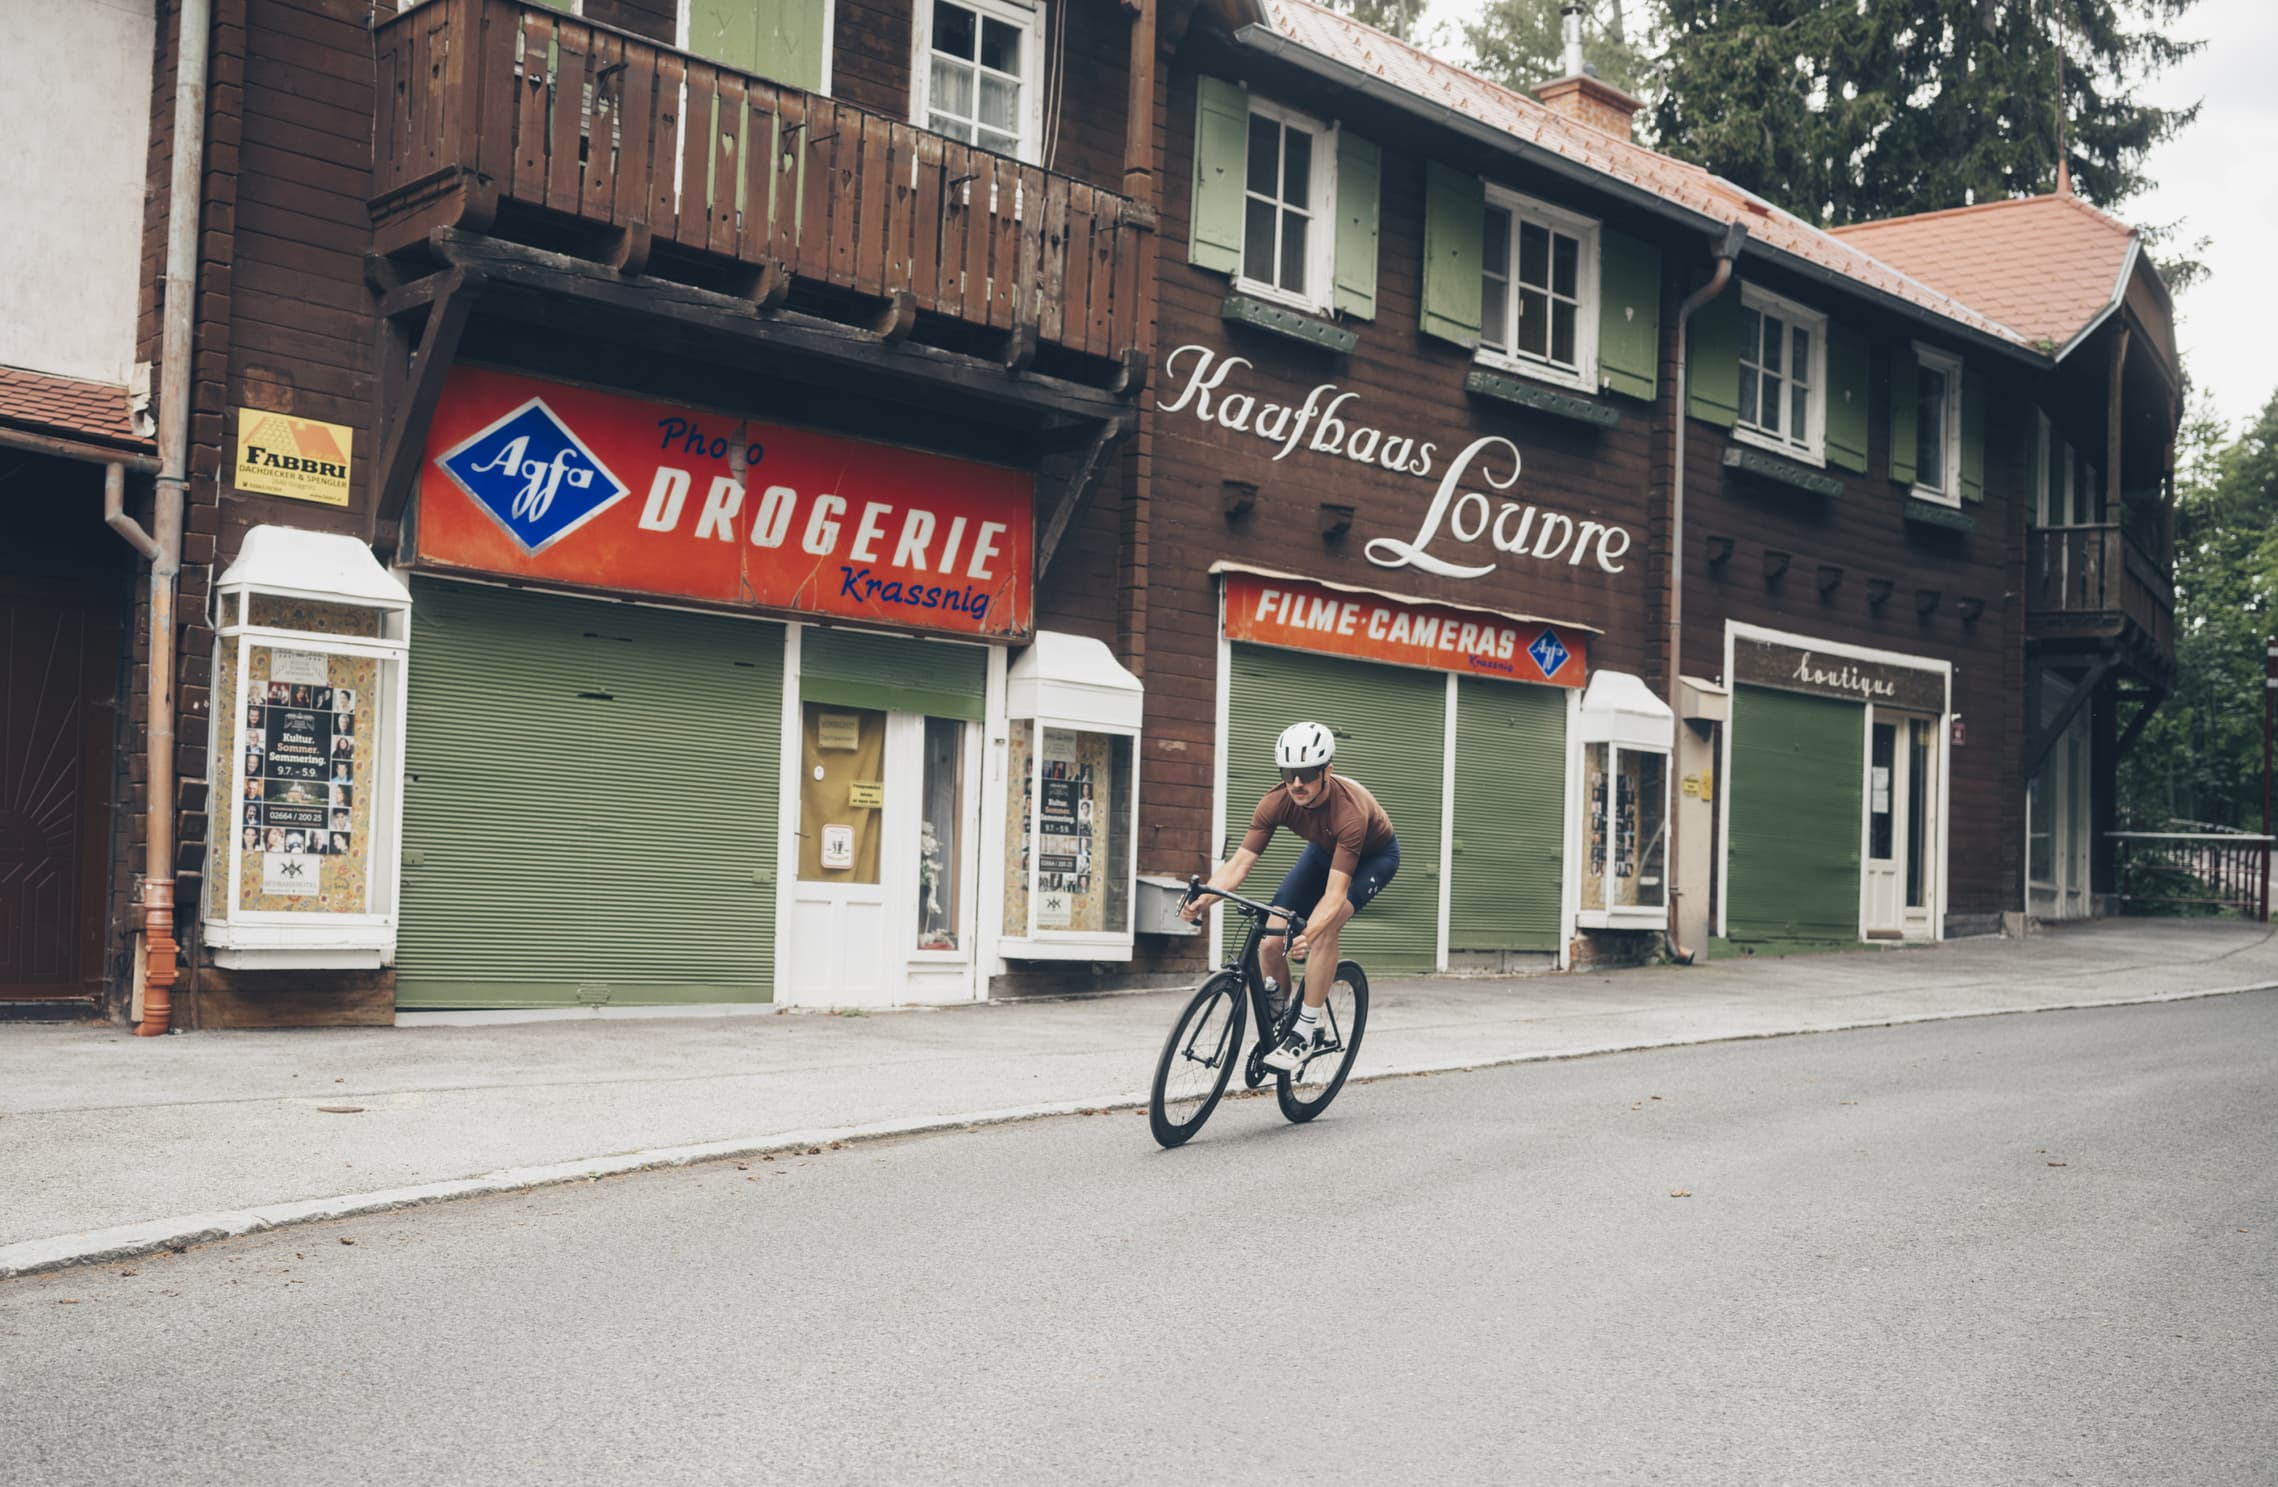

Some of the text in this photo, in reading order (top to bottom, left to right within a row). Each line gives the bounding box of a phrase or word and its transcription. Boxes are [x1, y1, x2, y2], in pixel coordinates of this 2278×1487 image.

[1156, 344, 1437, 476] Kaufhaus
[246, 445, 347, 479] FABBRI
[657, 417, 764, 466] Phoo
[239, 464, 295, 481] DACHDECKER
[299, 473, 304, 481] &
[306, 475, 347, 488] SPENGLER
[471, 435, 594, 523] Agfa
[638, 466, 1007, 580] DROGERIE
[1364, 436, 1630, 578] Louvre
[840, 566, 990, 620] Krassnig
[1532, 638, 1564, 671] Agfa
[1792, 651, 1895, 698] boutique
[269, 752, 327, 766] Semmering.
[277, 743, 320, 754] Sommer.
[282, 733, 315, 744] Kultur.
